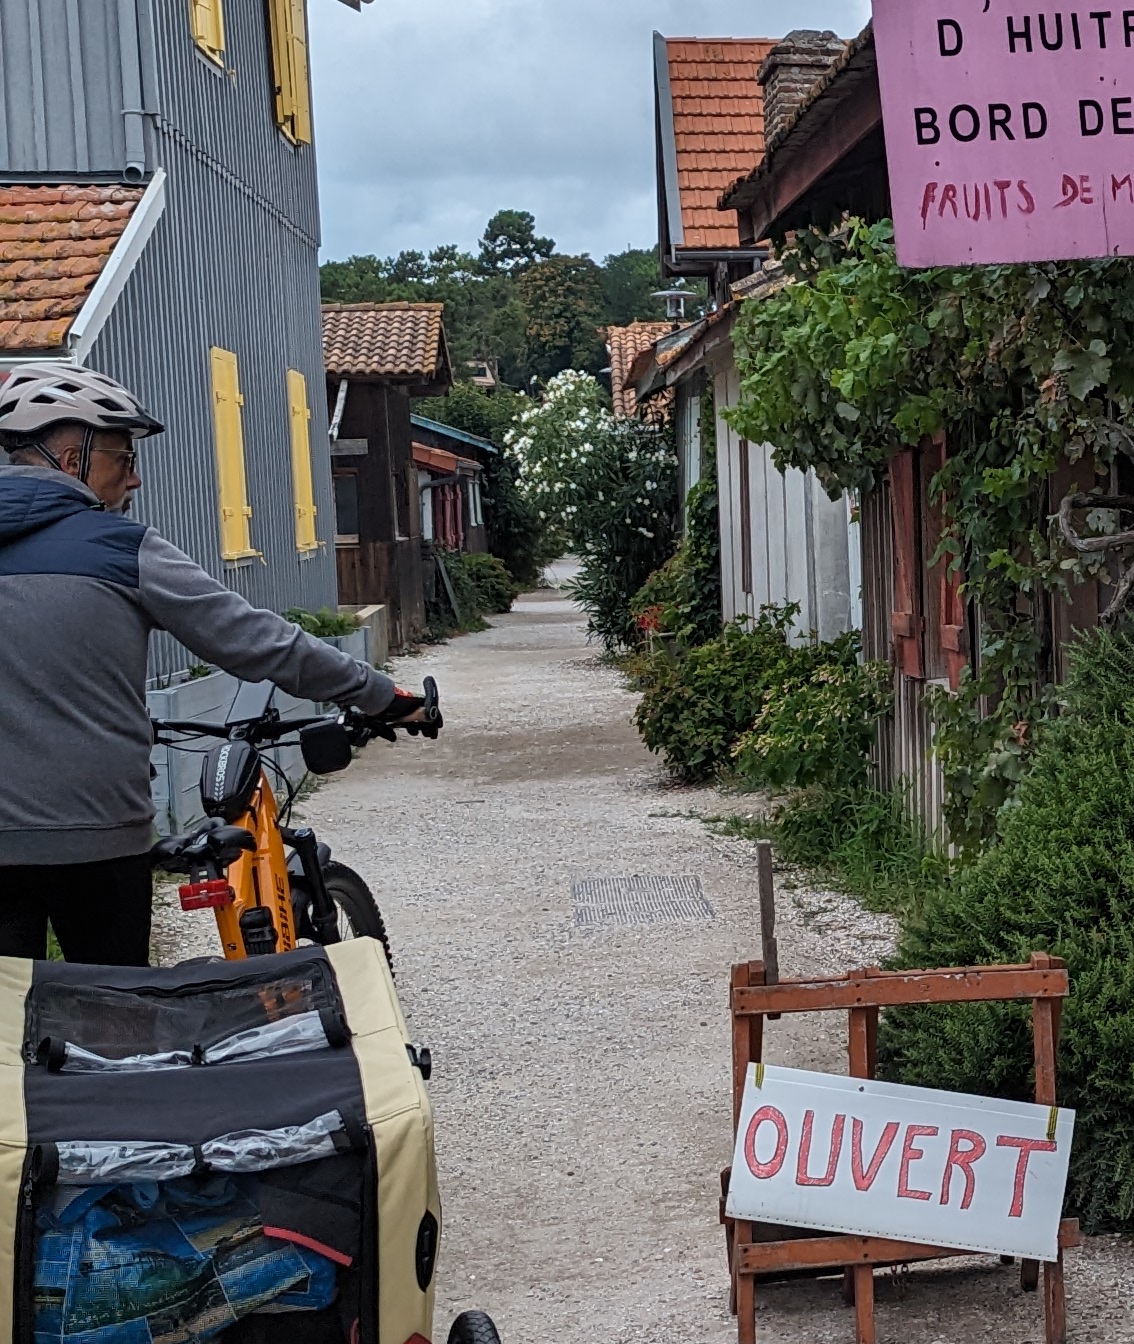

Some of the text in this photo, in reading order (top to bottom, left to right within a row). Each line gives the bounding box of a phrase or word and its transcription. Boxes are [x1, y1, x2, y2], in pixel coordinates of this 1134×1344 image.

[914, 101, 1048, 145] BORD
[1079, 97, 1134, 136] DE
[921, 179, 1036, 230] FRUITS
[1054, 174, 1094, 209] DE
[275, 872, 292, 953] IBIKE
[744, 1105, 1058, 1218] OUVERT
